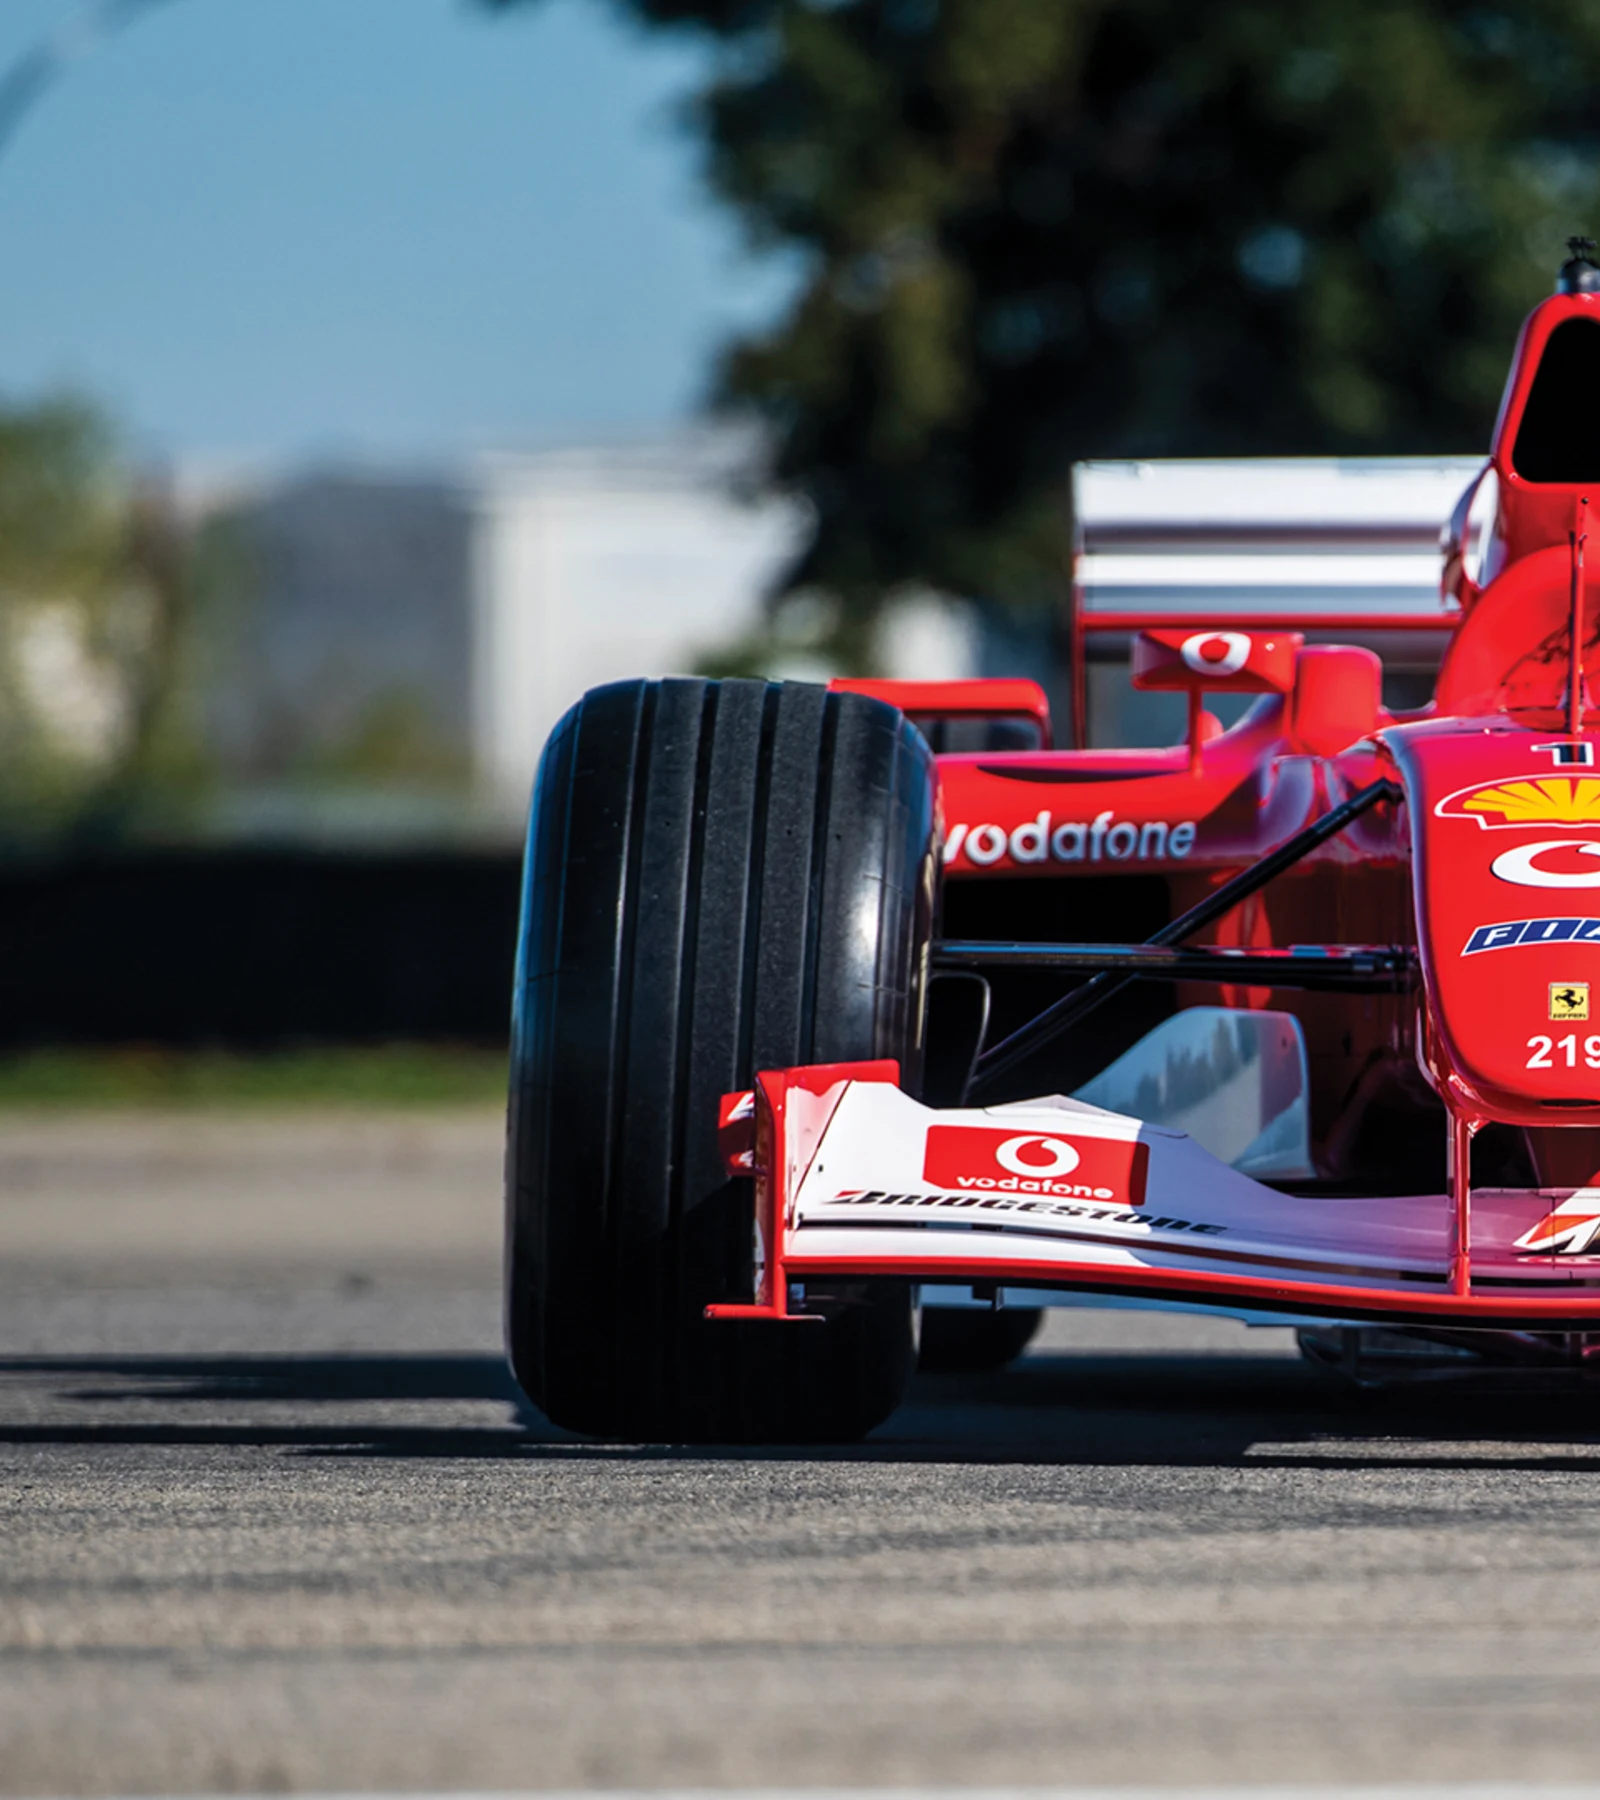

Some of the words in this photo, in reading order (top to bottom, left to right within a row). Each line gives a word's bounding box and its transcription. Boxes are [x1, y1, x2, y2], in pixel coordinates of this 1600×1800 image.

[943, 810, 1196, 865] vodafone
[957, 1175, 1114, 1200] vodafone
[824, 1190, 1228, 1235] BRIDGESTONE
